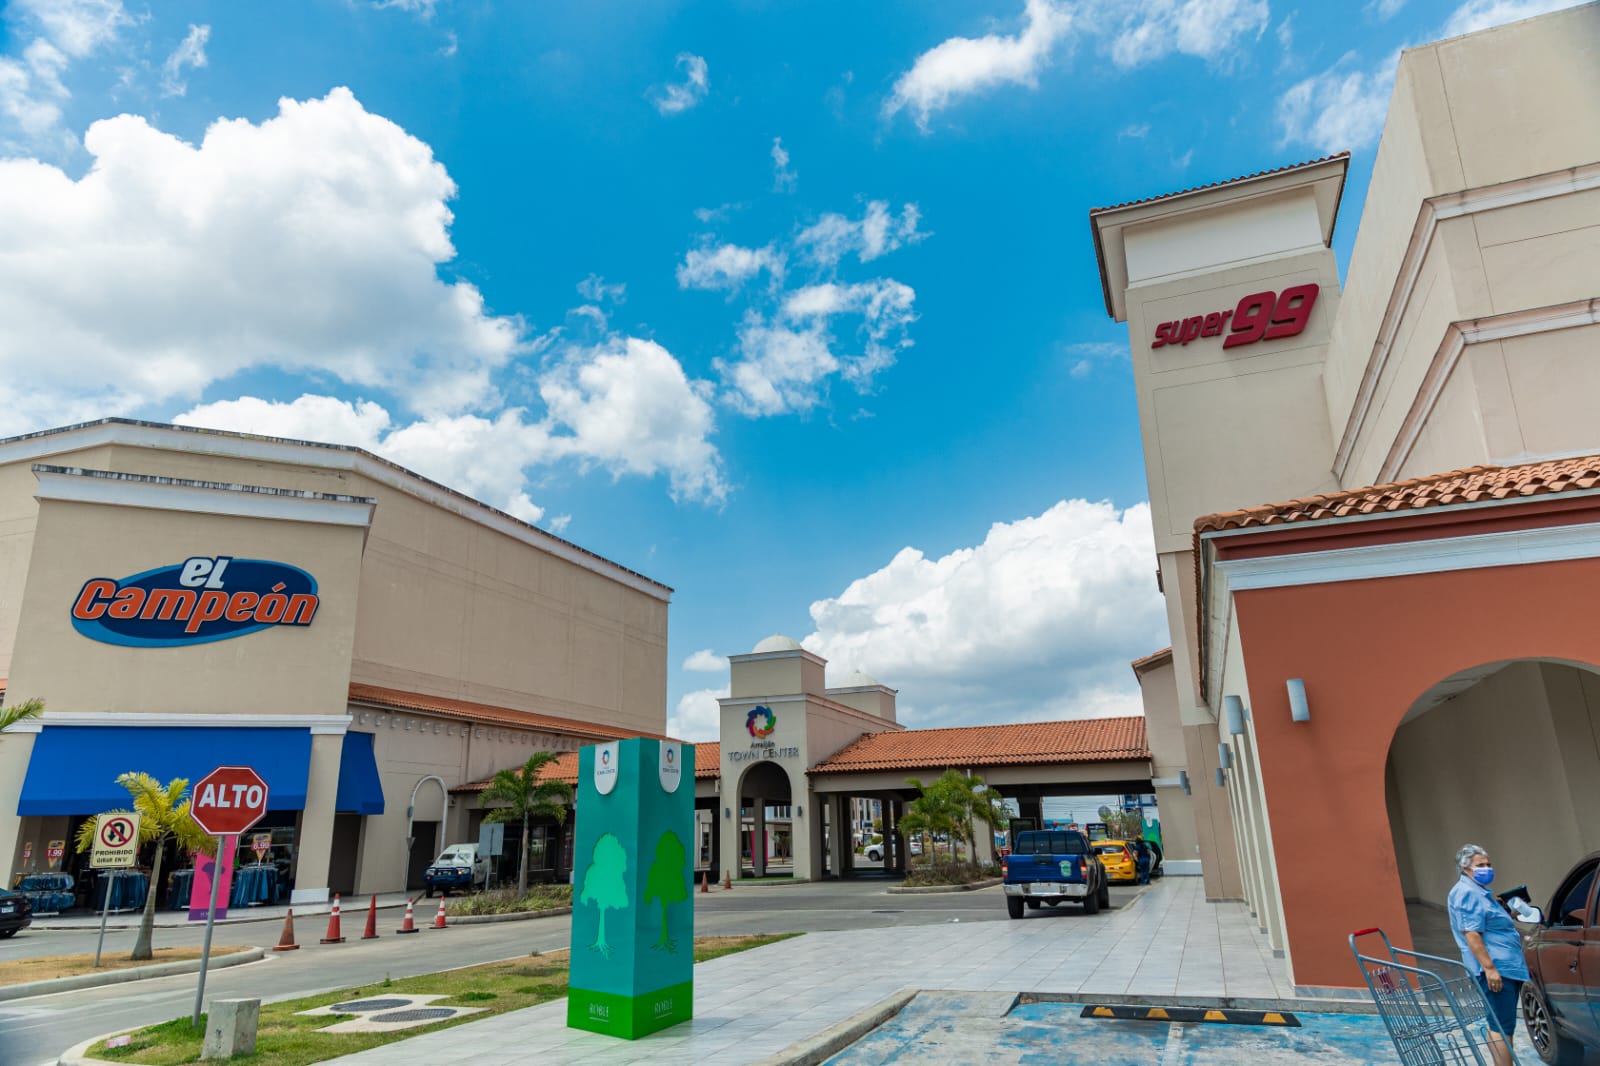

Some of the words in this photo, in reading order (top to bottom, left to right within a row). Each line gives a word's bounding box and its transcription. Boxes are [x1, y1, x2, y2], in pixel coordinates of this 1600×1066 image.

[179, 558, 230, 589] el
[72, 580, 319, 633] Campeón
[728, 750, 760, 761] TOWN
[762, 747, 800, 759] CENTER
[198, 783, 263, 809] ALTO
[95, 849, 134, 857] PROHIBIDO
